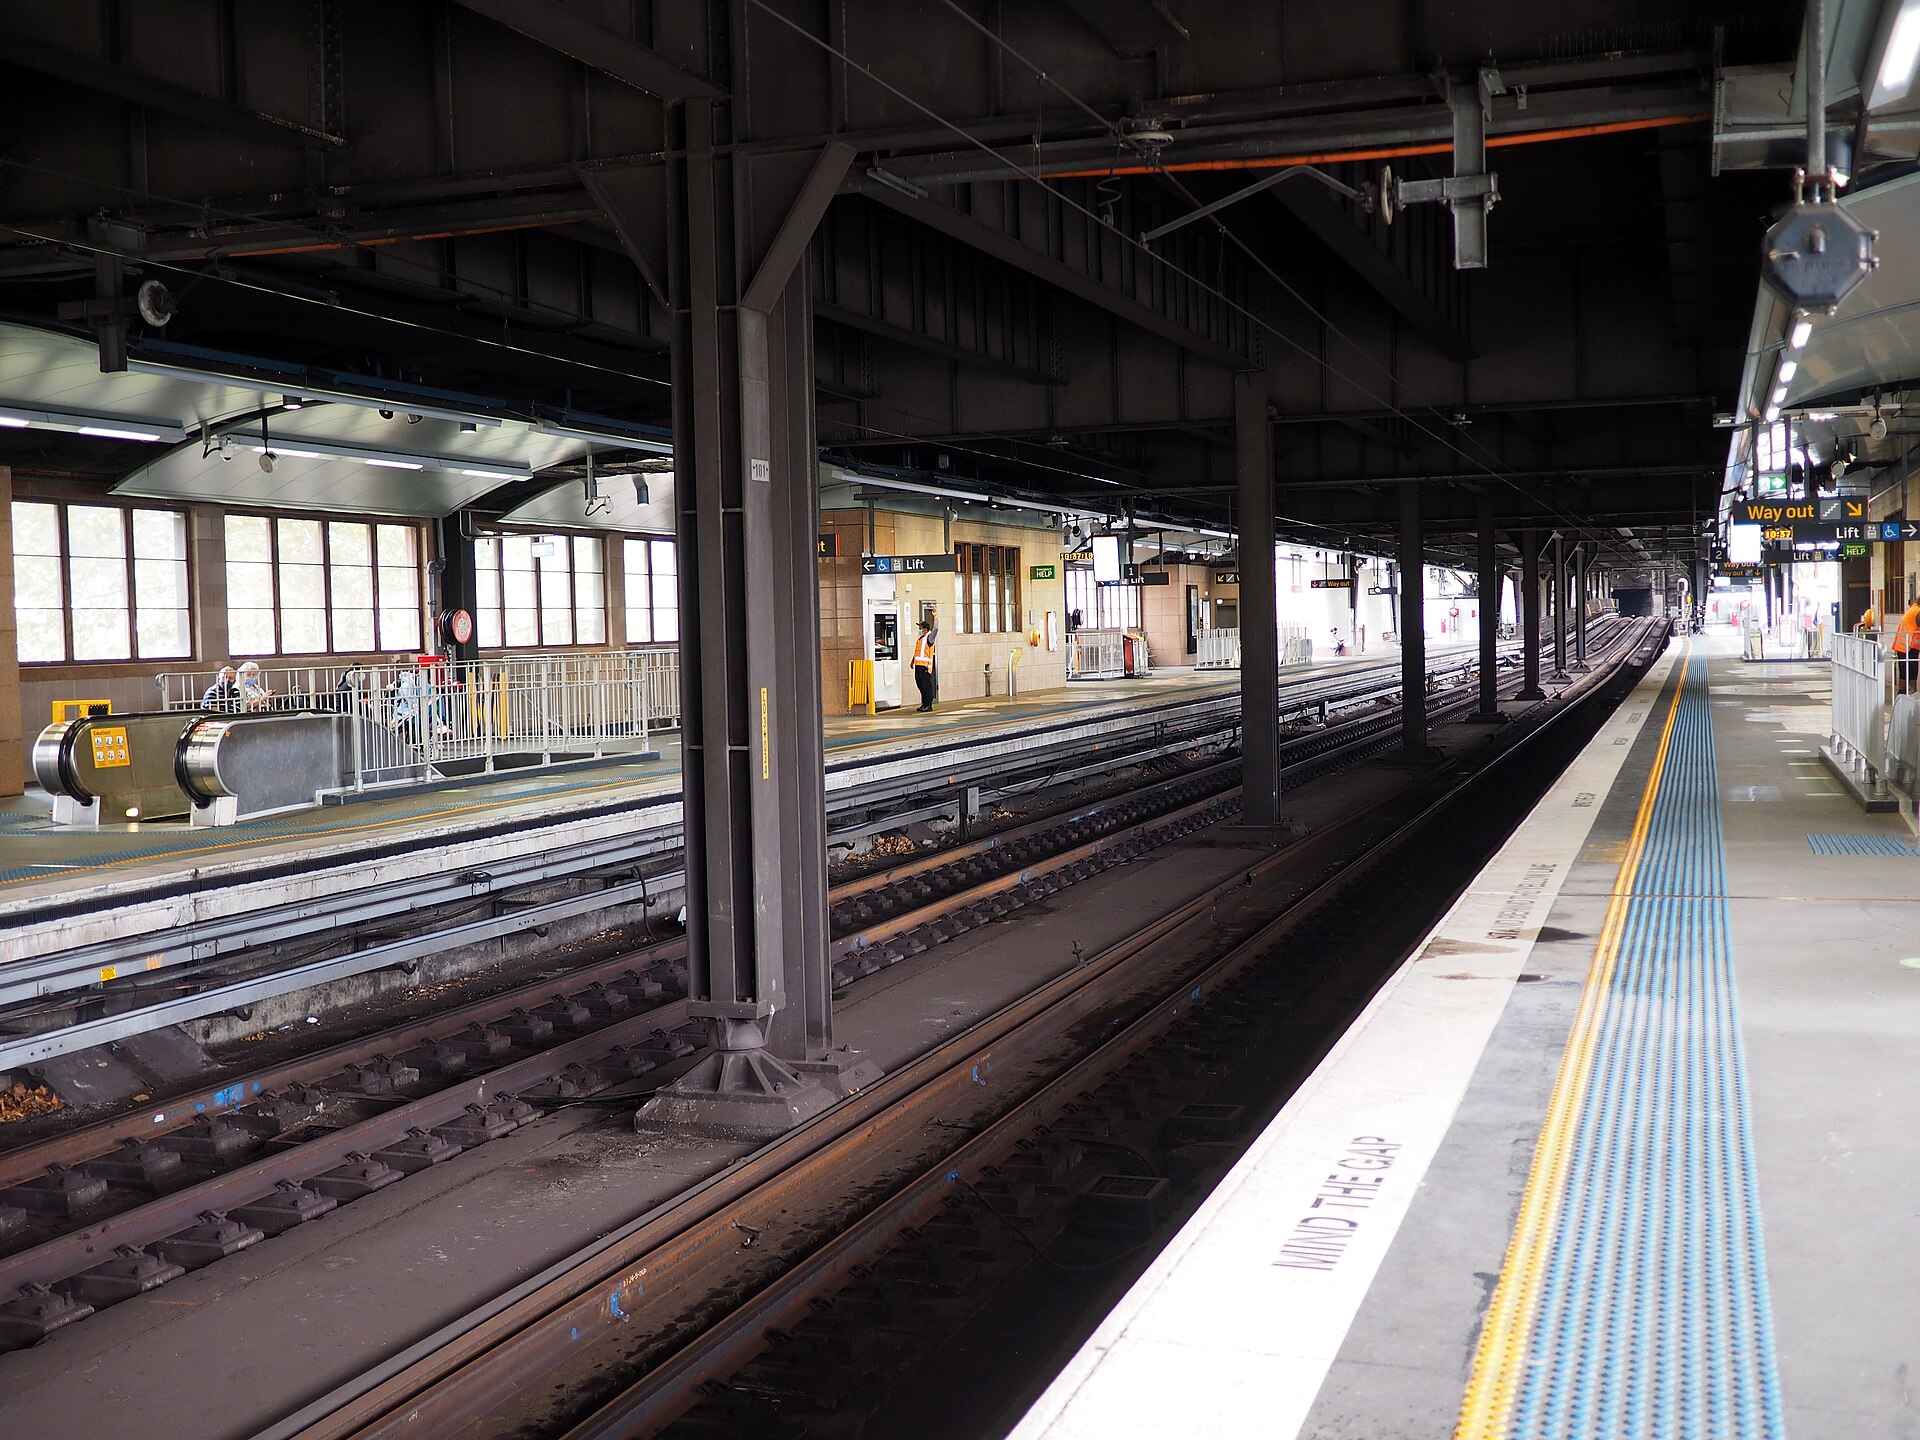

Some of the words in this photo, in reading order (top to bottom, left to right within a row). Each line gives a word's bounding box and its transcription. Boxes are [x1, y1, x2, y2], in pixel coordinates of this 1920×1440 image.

[755, 464, 766, 477] 101
[1747, 506, 1782, 522] Way
[1786, 505, 1814, 518] out
[1836, 527, 1860, 539] Lift
[1715, 550, 1723, 560] 2
[1793, 552, 1810, 560] Lift
[906, 559, 925, 570] Lift
[1128, 567, 1134, 575] 1
[1337, 1136, 1402, 1170] GAP
[1310, 1174, 1384, 1208] THE
[1271, 1216, 1359, 1271] MIND
